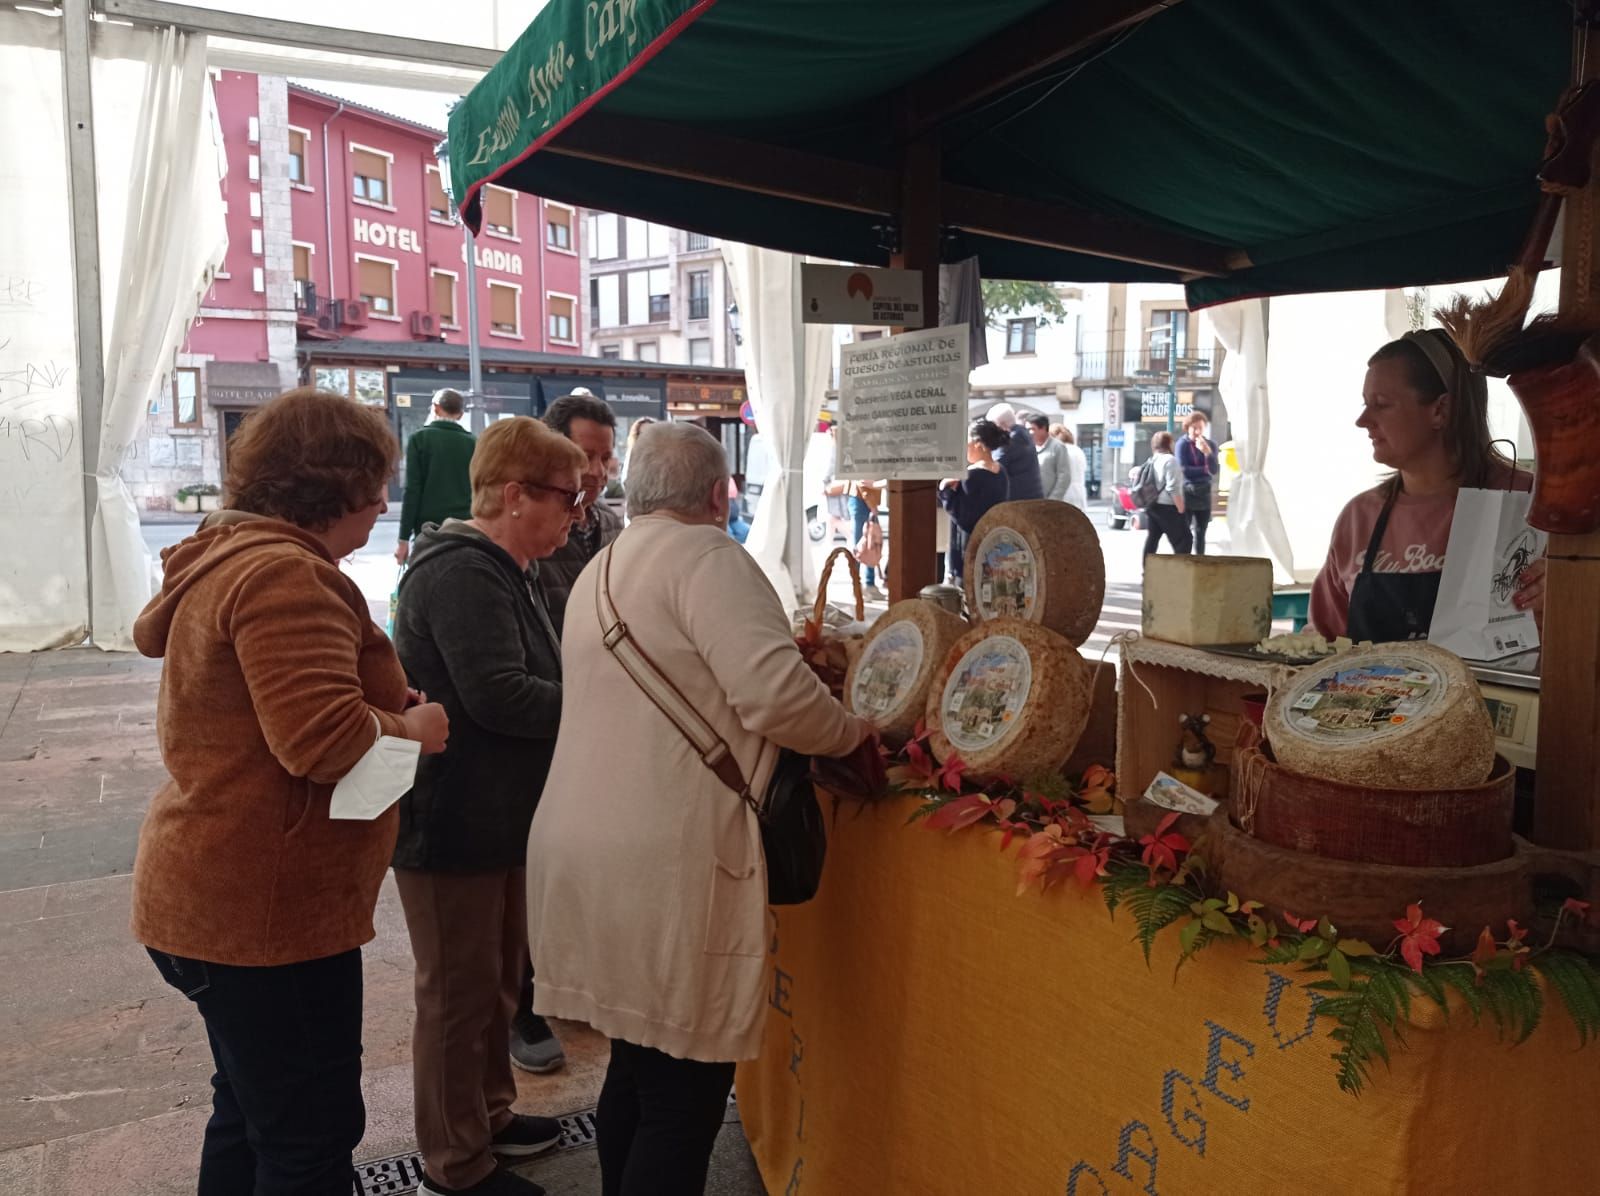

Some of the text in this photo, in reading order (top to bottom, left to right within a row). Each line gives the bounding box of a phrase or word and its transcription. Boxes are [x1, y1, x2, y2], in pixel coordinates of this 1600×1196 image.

[527, 40, 575, 128] Ayto.
[354, 217, 422, 254] HOTEL
[873, 312, 905, 321] DE ASTURIAS
[881, 340, 935, 359] REGIONAL
[938, 338, 956, 350] DE
[844, 362, 886, 376] QUESOS
[902, 352, 961, 368] ASTURIAS
[890, 390, 913, 401] VEGA
[914, 386, 947, 399] CEÑAL
[910, 406, 927, 416] DEL
[928, 403, 958, 415] VALLE
[1141, 404, 1194, 416] CUADRDOS
